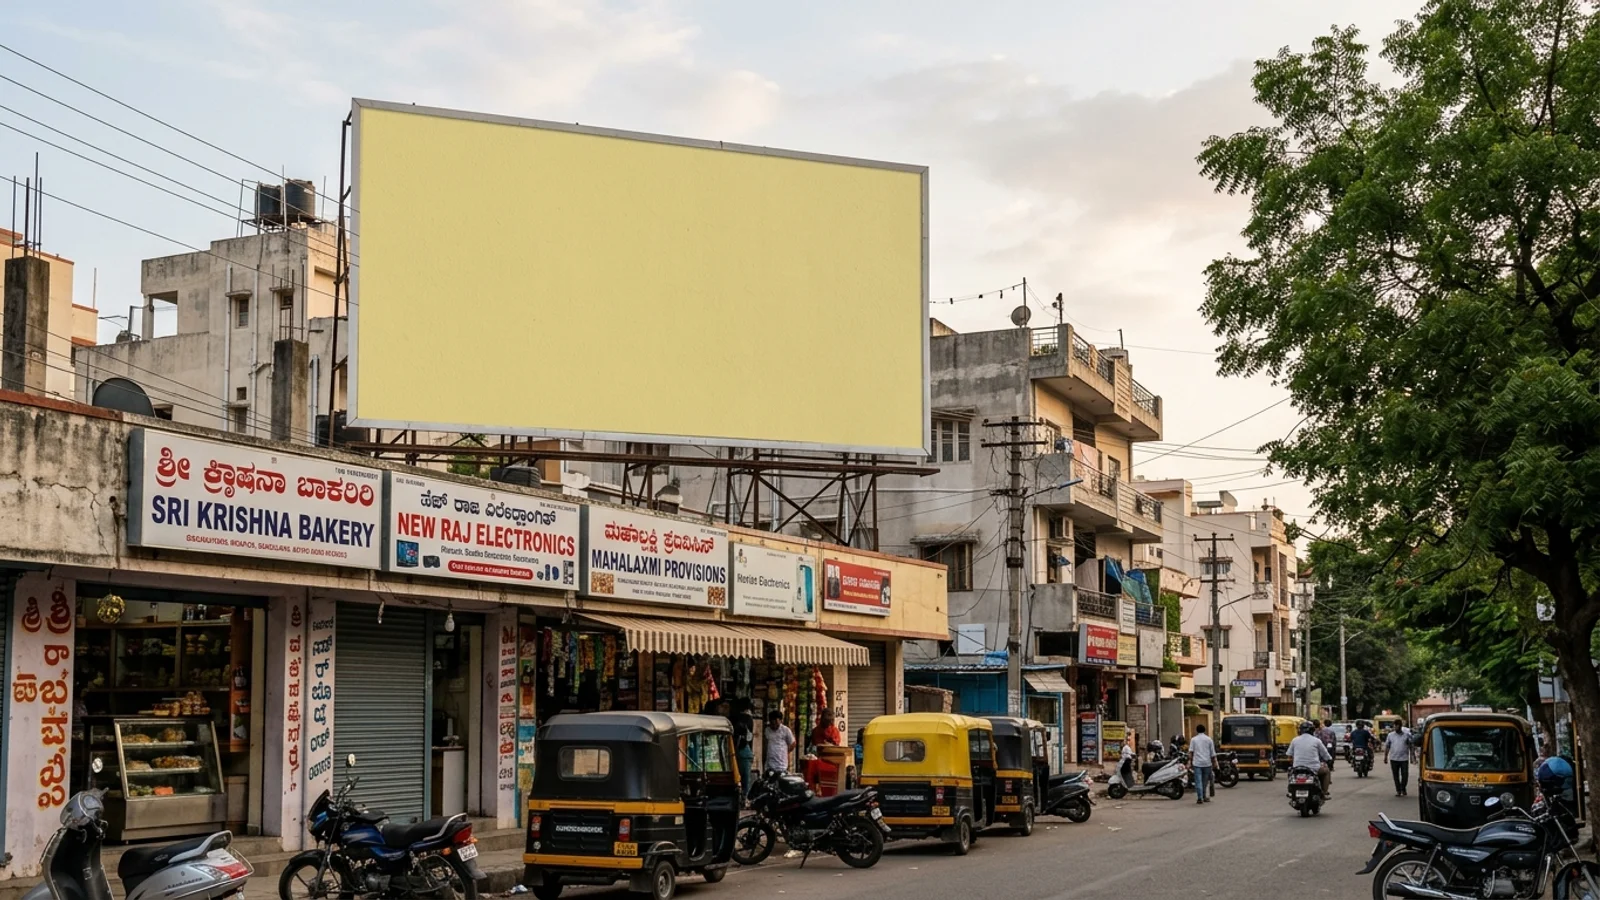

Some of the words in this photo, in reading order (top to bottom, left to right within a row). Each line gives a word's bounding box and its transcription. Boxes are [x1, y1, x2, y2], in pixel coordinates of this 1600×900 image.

[151, 494, 190, 527] SRI
[197, 500, 293, 539] KRISHNA
[299, 513, 375, 549] BAKERY
[397, 512, 436, 539] NEW
[441, 518, 471, 544] RAJ
[476, 523, 575, 557] ELECTRONICS
[591, 548, 661, 577] MAHALAXMI
[664, 559, 726, 584] PROVISIONS
